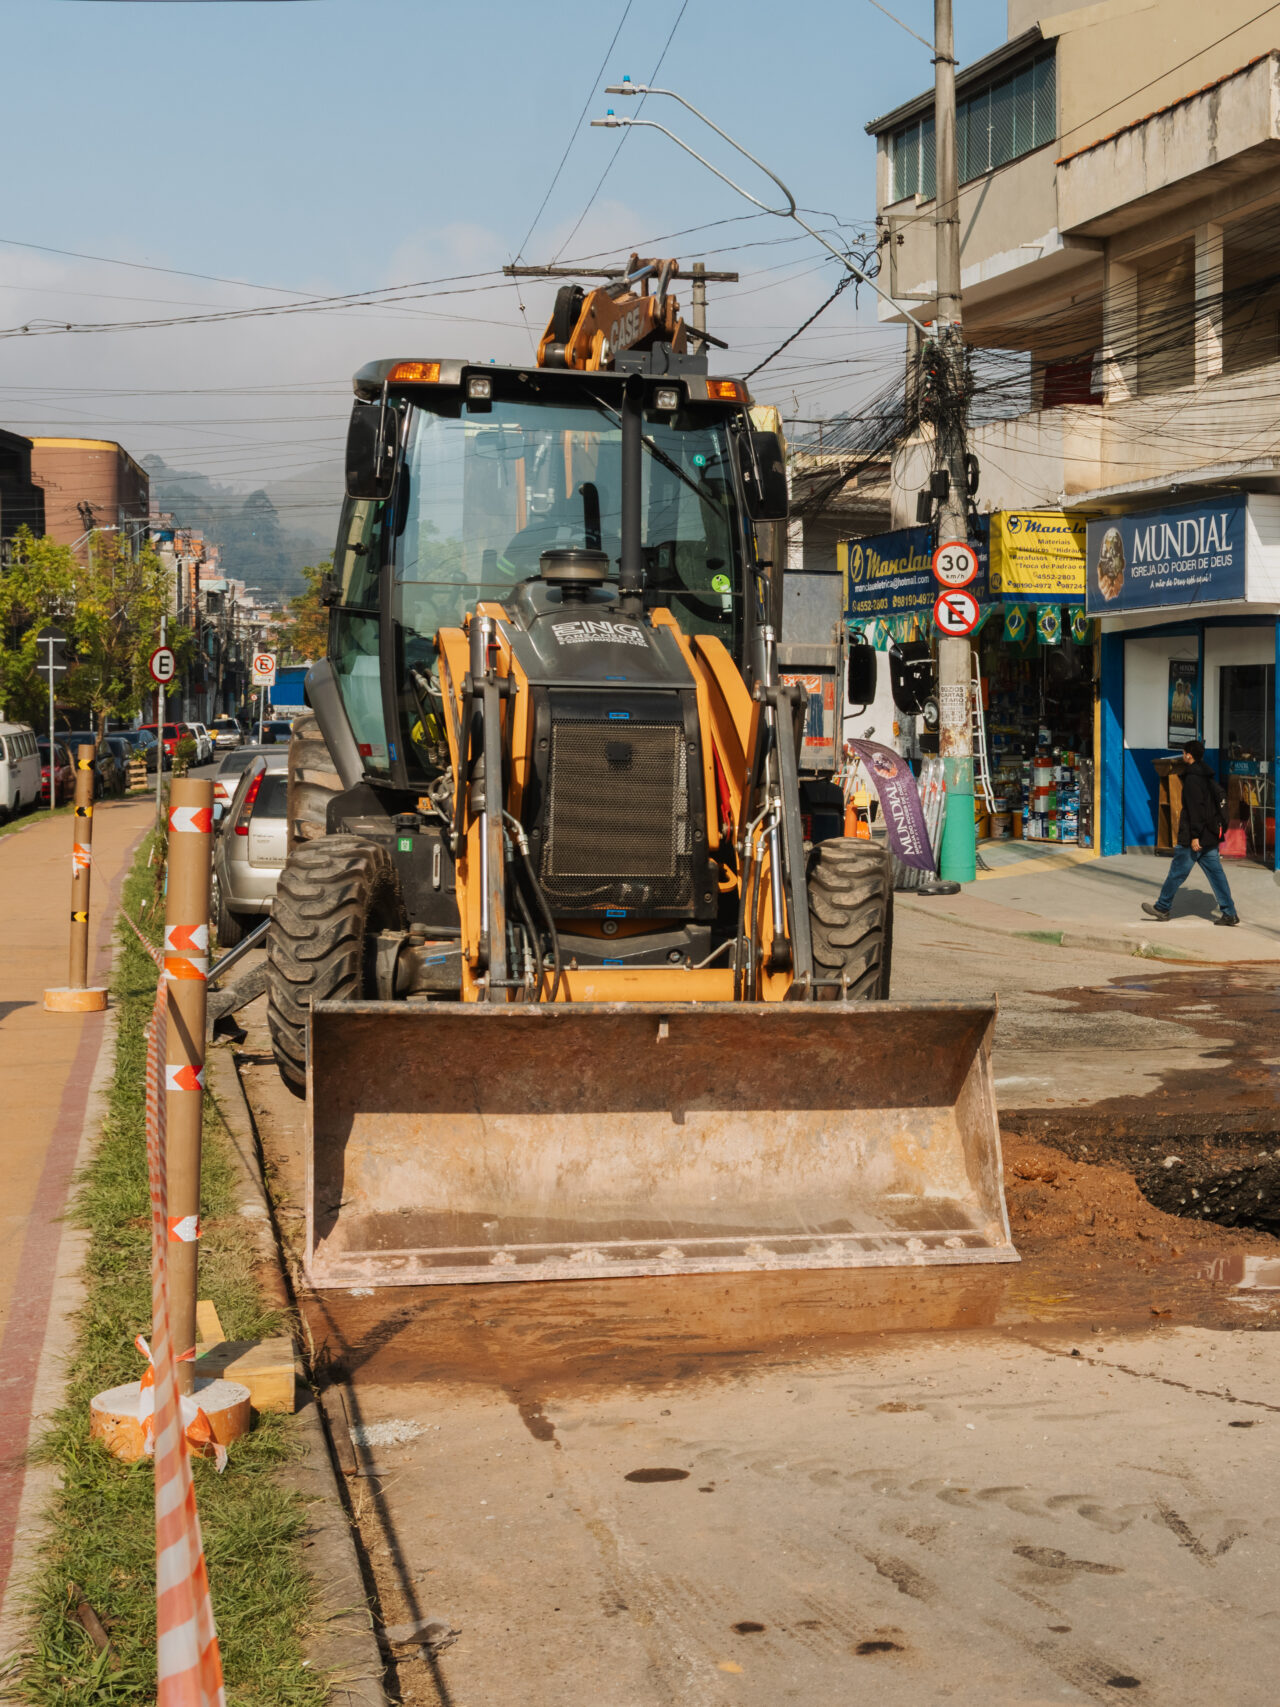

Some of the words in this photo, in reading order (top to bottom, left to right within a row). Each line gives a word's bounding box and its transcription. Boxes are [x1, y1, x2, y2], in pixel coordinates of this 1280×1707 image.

[611, 306, 640, 354] CASE
[1132, 513, 1233, 564] MUNDIAL
[942, 554, 969, 571] 30
[1131, 564, 1157, 578] IGREJA
[1157, 563, 1170, 574] DO
[1171, 559, 1198, 573] PODER
[1197, 557, 1209, 569] DE
[1210, 554, 1233, 568] DEUS
[948, 600, 965, 624] E
[159, 655, 170, 674] E
[886, 782, 915, 855] MUNDIAL
